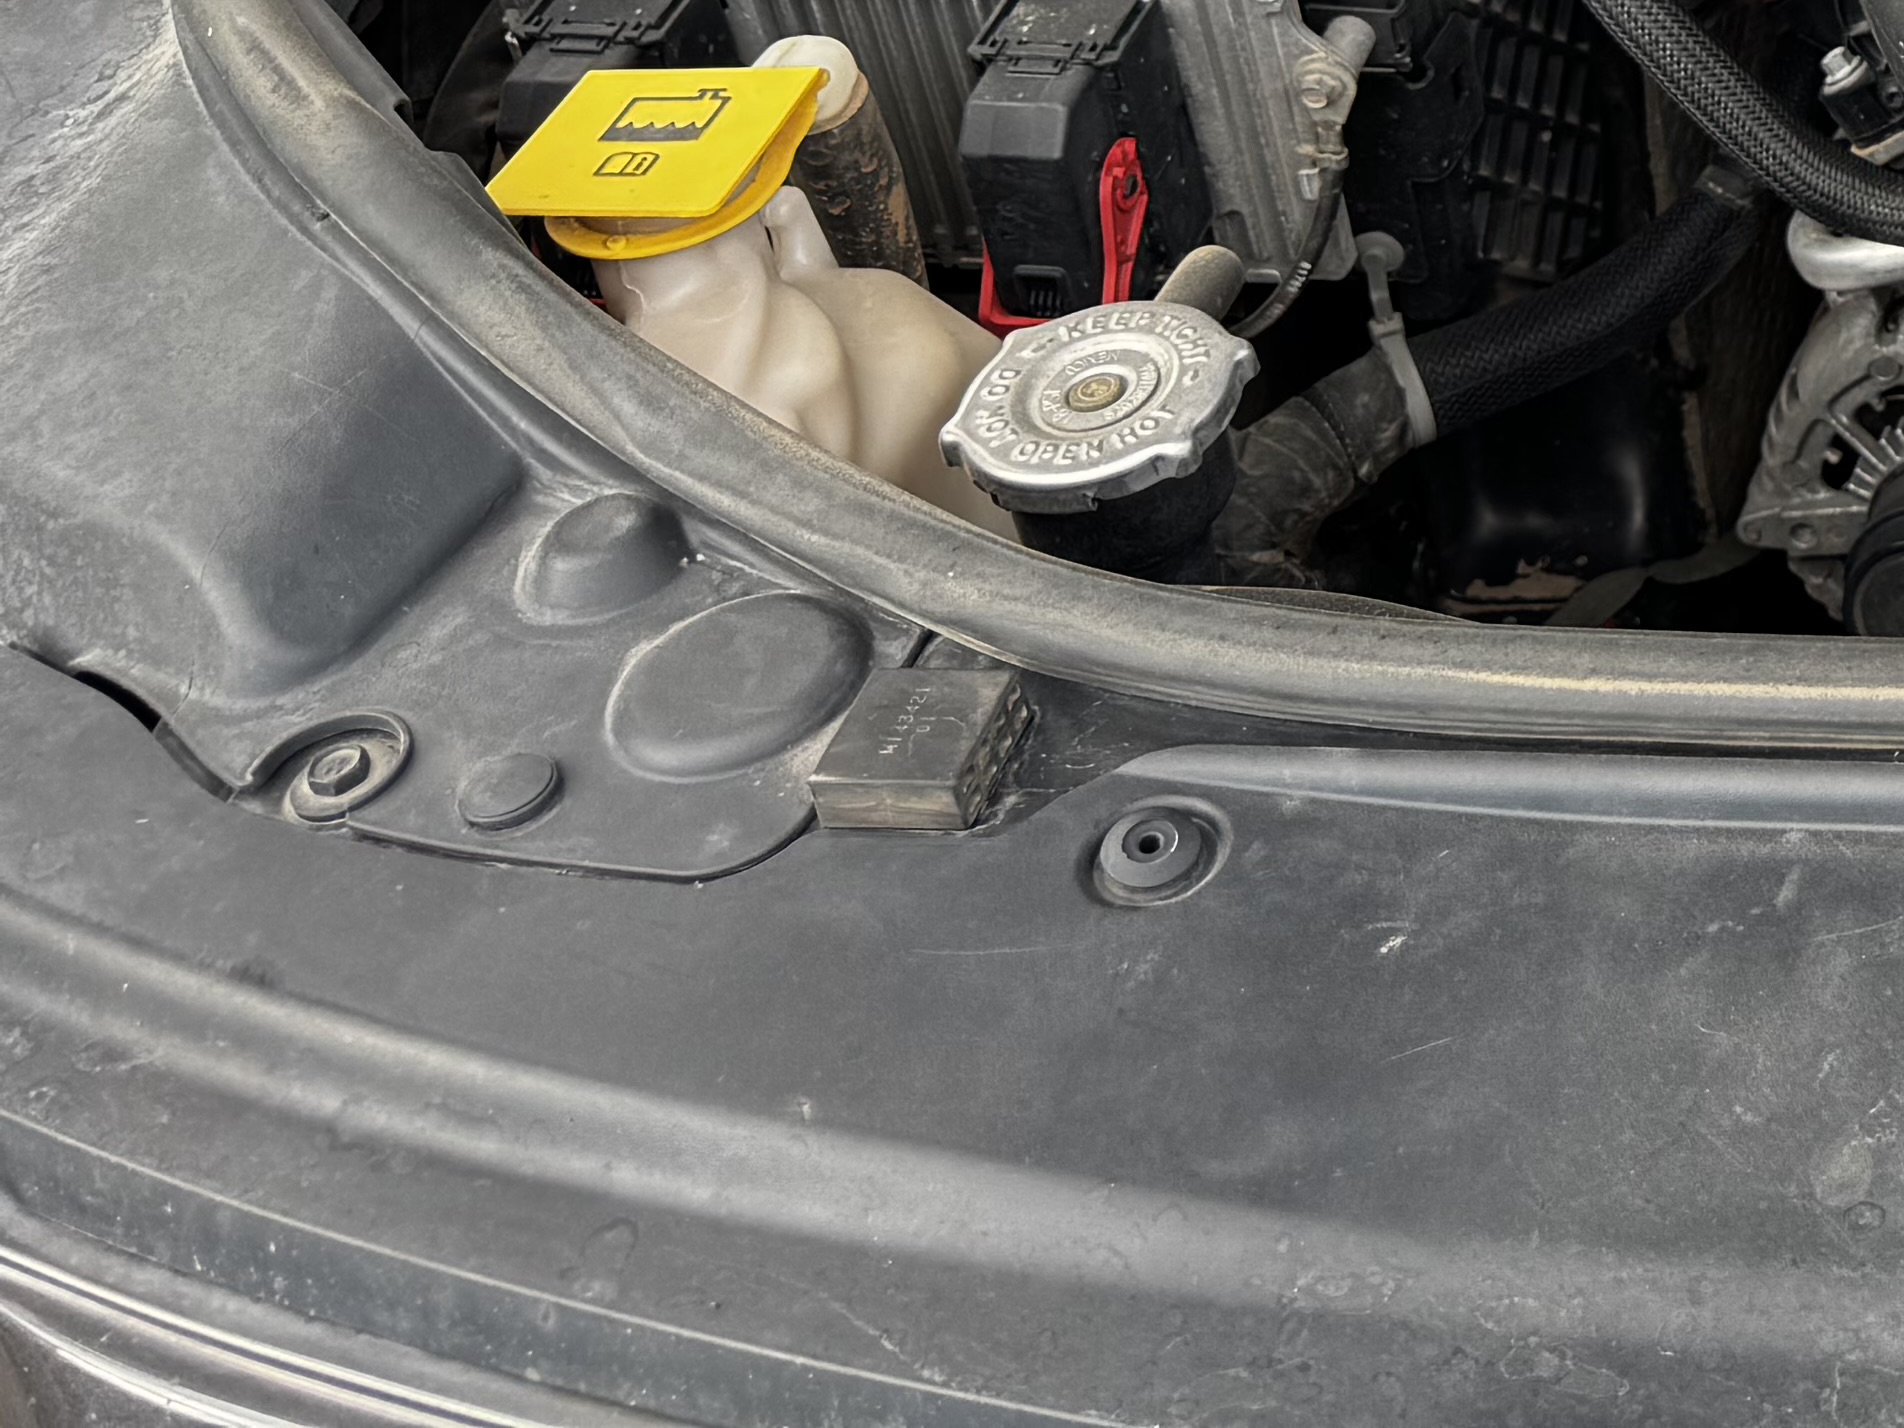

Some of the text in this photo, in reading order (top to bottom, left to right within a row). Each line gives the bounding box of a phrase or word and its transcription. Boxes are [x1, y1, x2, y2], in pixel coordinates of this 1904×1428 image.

[1058, 310, 1151, 342] KEEP
[980, 367, 1022, 401] DO
[1010, 440, 1105, 466] OPEN
[1109, 403, 1176, 451] HOT
